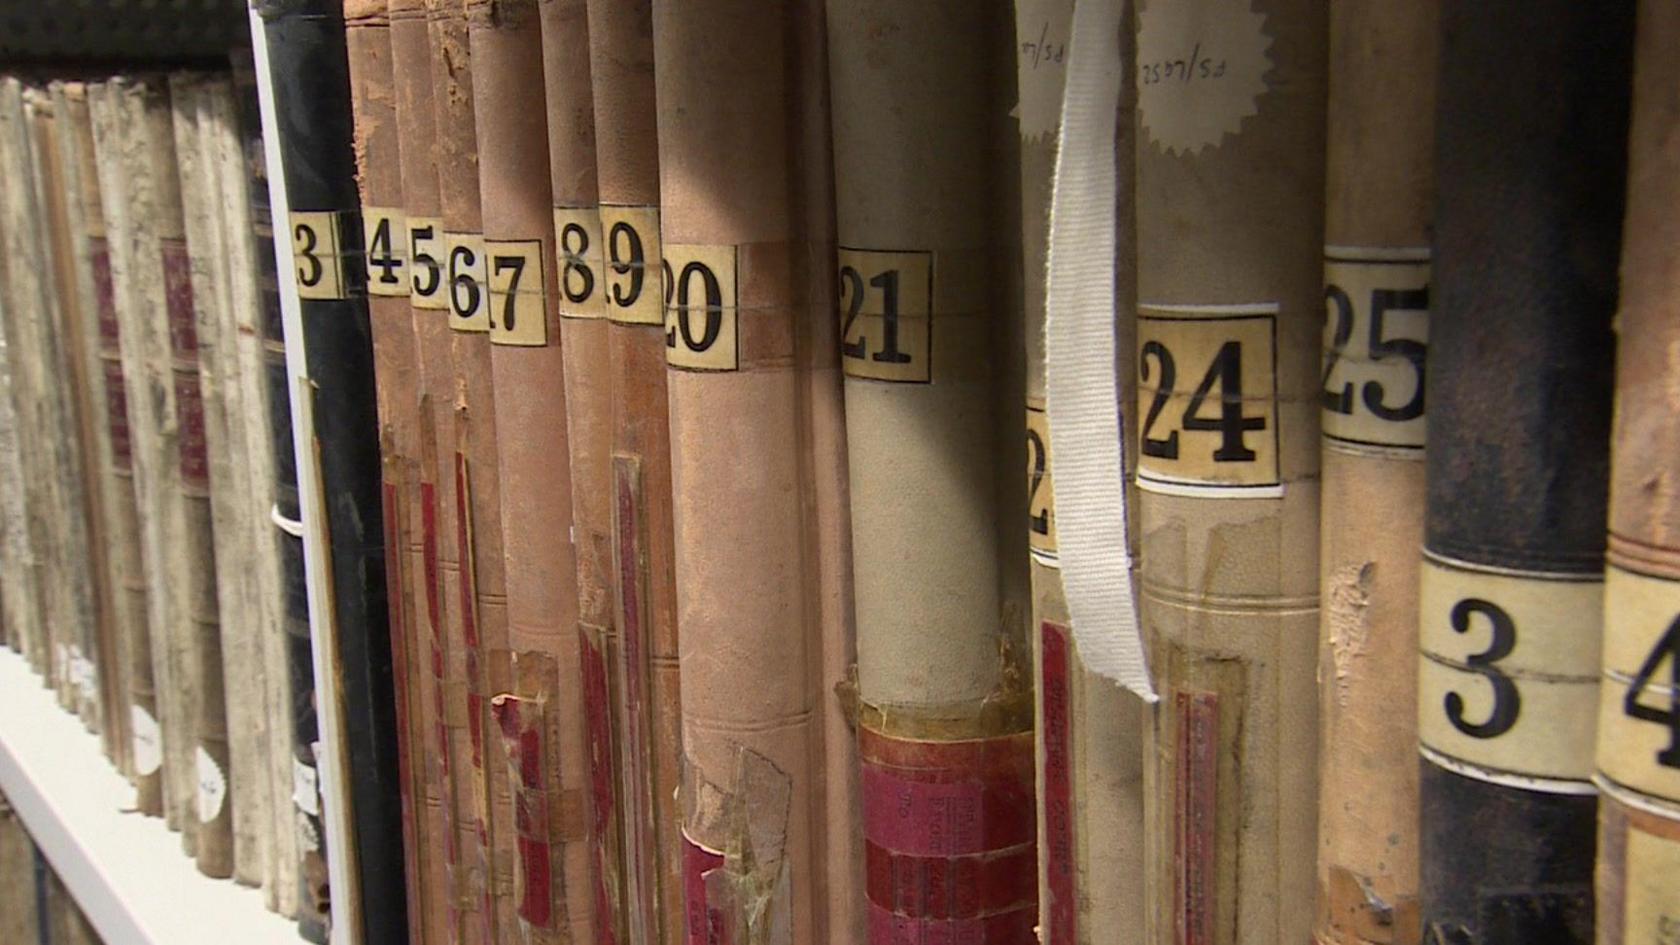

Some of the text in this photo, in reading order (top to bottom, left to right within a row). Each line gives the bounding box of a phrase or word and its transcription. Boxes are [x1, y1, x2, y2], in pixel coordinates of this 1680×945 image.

[367, 218, 402, 283] 4
[411, 225, 441, 297] 5
[449, 246, 481, 318] 6
[561, 223, 595, 304] 8
[840, 265, 912, 364] 21
[1322, 284, 1429, 423] 25
[1140, 340, 1266, 462] 24
[1027, 428, 1055, 536] 2
[1443, 597, 1521, 739] 3
